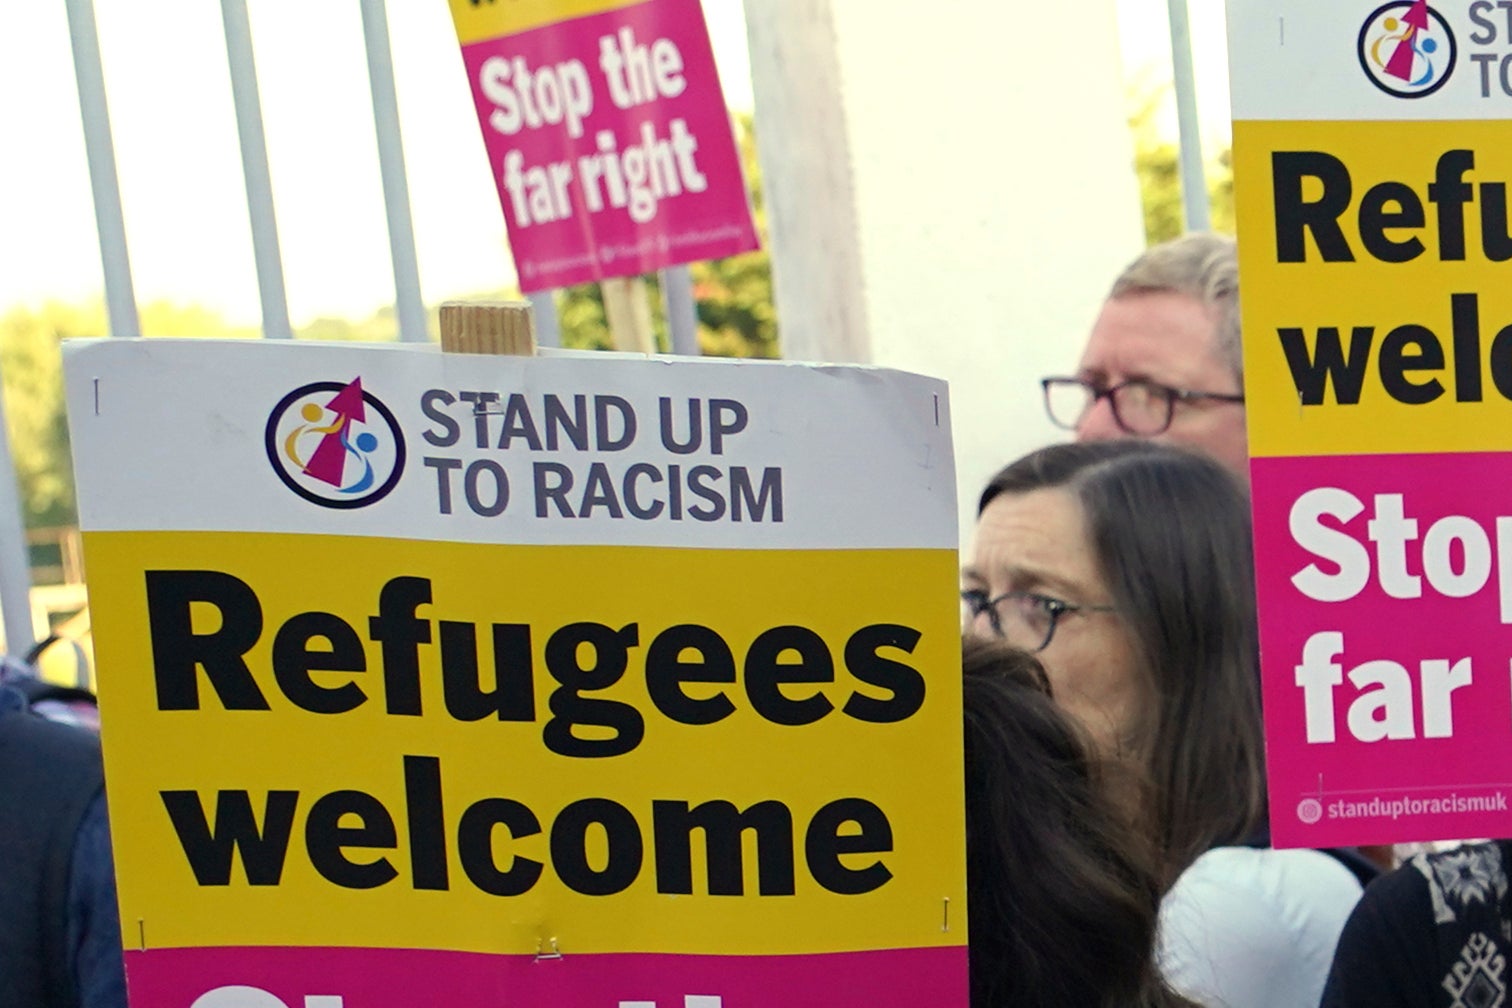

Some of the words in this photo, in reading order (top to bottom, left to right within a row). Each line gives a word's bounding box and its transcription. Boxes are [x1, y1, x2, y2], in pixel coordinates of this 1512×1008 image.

[480, 56, 593, 139] Stop
[600, 26, 686, 109] the
[504, 150, 573, 227] far
[578, 119, 707, 223] right
[421, 389, 637, 451] STAND
[659, 397, 748, 455] UP
[424, 457, 509, 517] TO
[533, 462, 783, 522] RACISM
[145, 570, 925, 758] Refugees
[1295, 632, 1472, 743] far
[159, 755, 893, 896] welcome
[1328, 792, 1507, 820] standuptoracismuk
